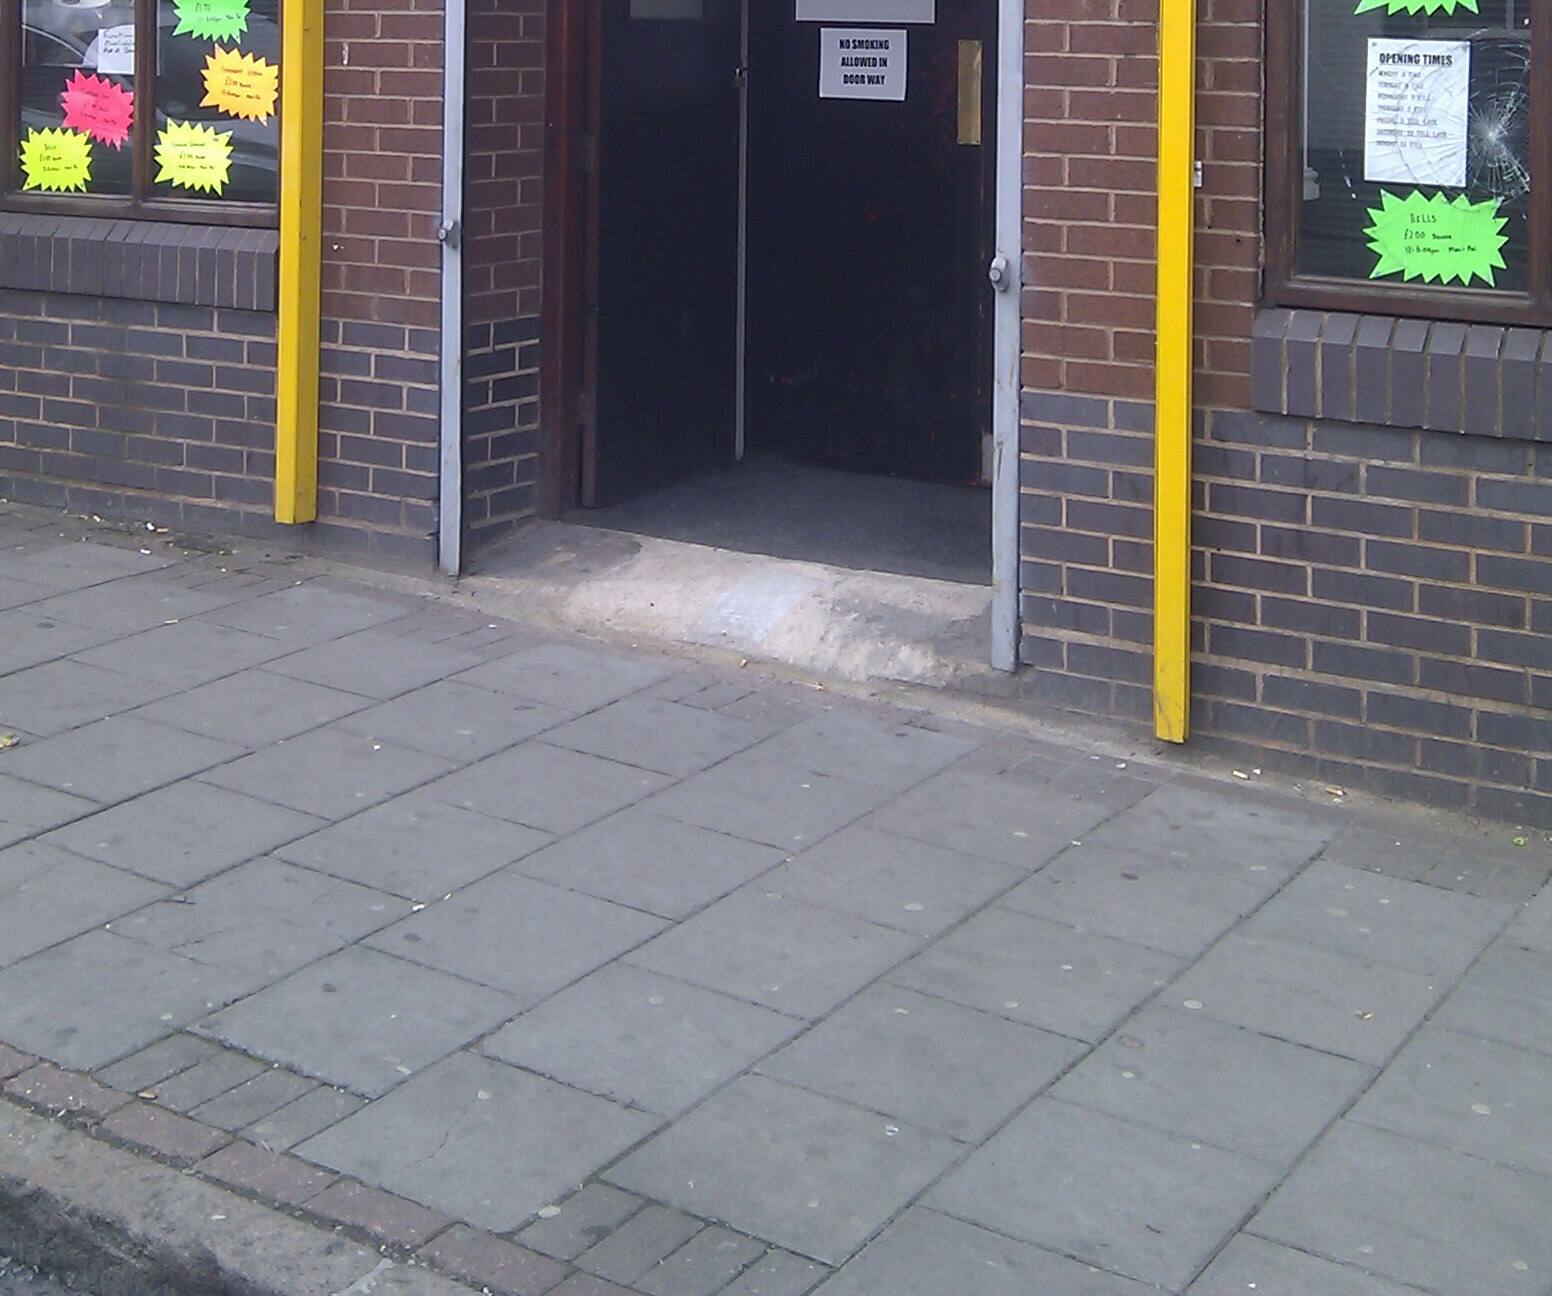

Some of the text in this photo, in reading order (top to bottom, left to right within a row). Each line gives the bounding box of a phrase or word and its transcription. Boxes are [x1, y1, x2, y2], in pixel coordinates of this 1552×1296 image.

[839, 39, 890, 50] NO SMOKING
[840, 56, 888, 68] ALLOWED IN
[1379, 53, 1454, 66] OPENING TIMES
[843, 74, 885, 85] DOOR WAY
